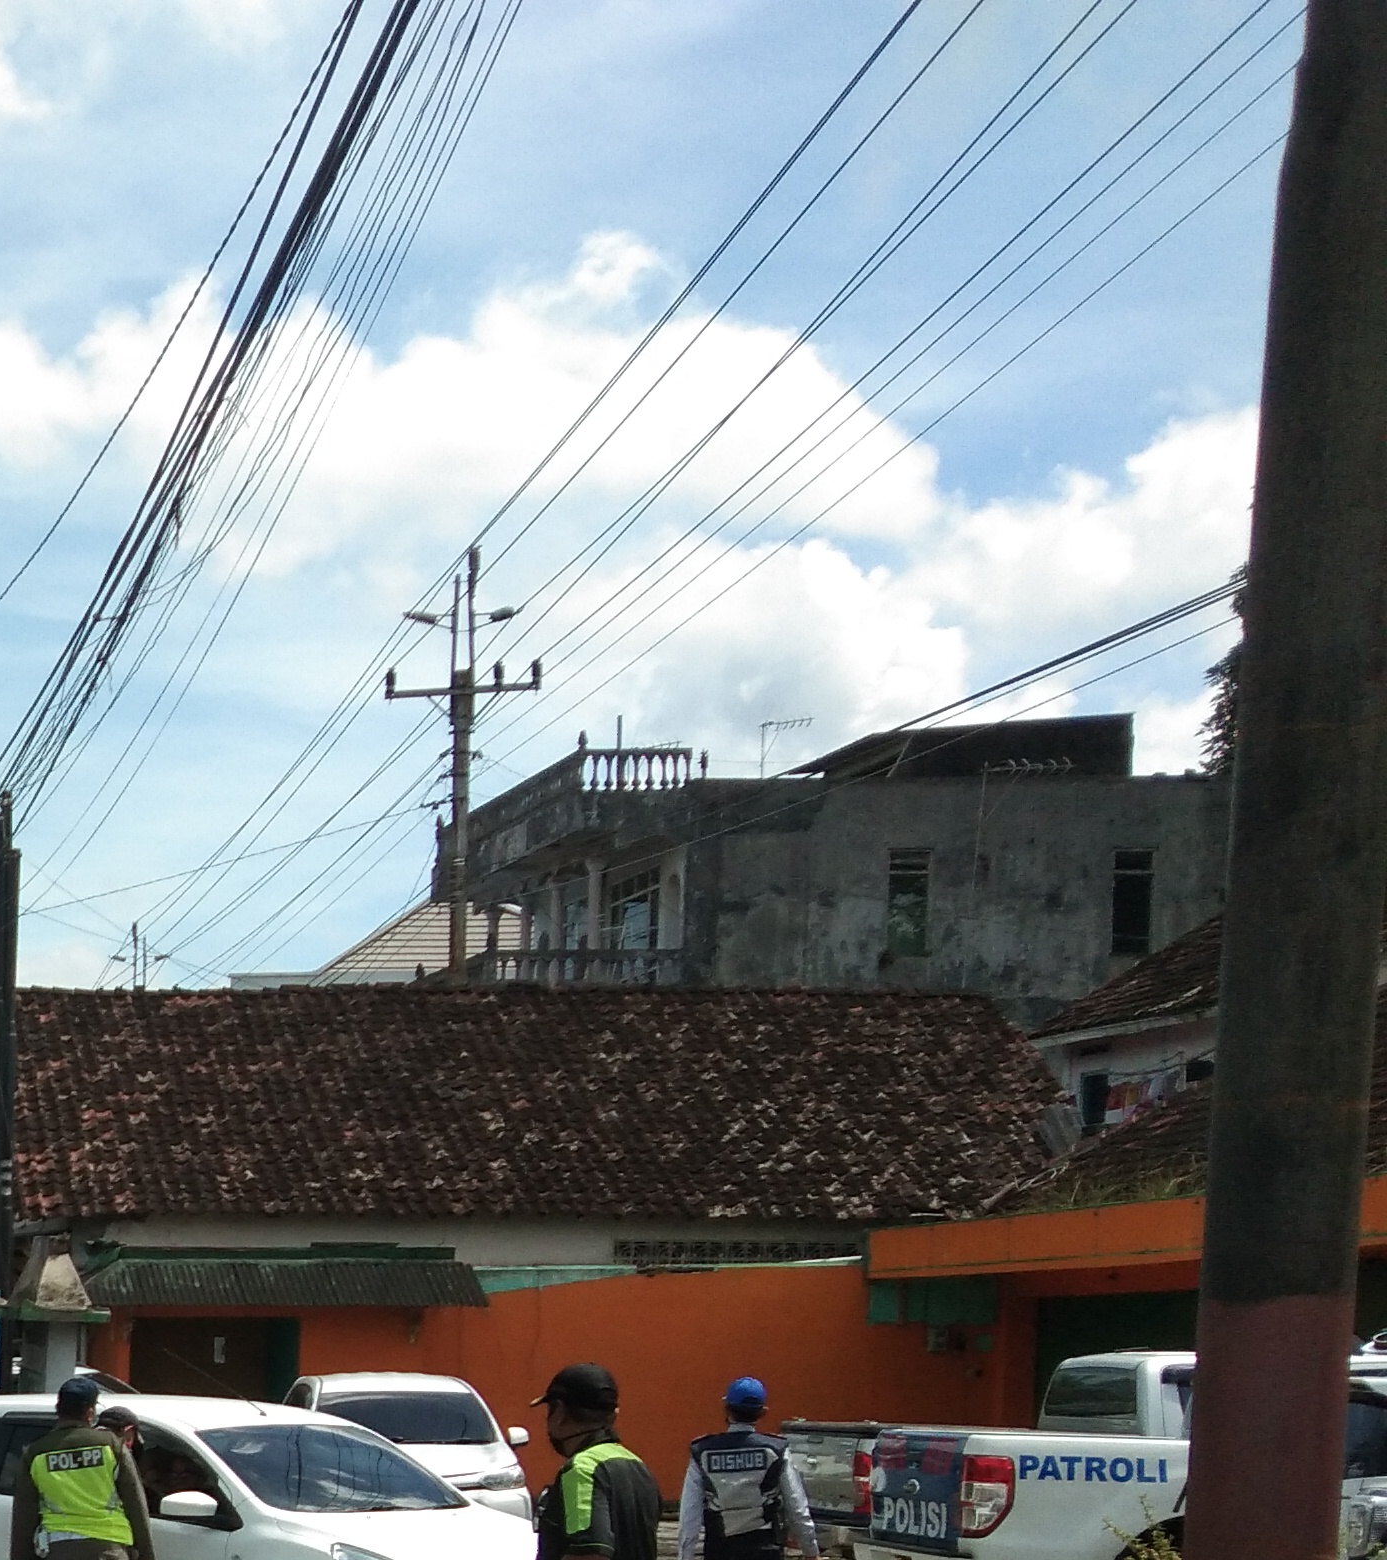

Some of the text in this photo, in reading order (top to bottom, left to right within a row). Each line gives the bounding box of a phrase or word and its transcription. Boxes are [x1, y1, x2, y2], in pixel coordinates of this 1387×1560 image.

[48, 1449, 102, 1470] POL-PP
[710, 1452, 765, 1470] DISHUB
[1019, 1455, 1168, 1483] PATROLI
[882, 1497, 947, 1539] POLISI
